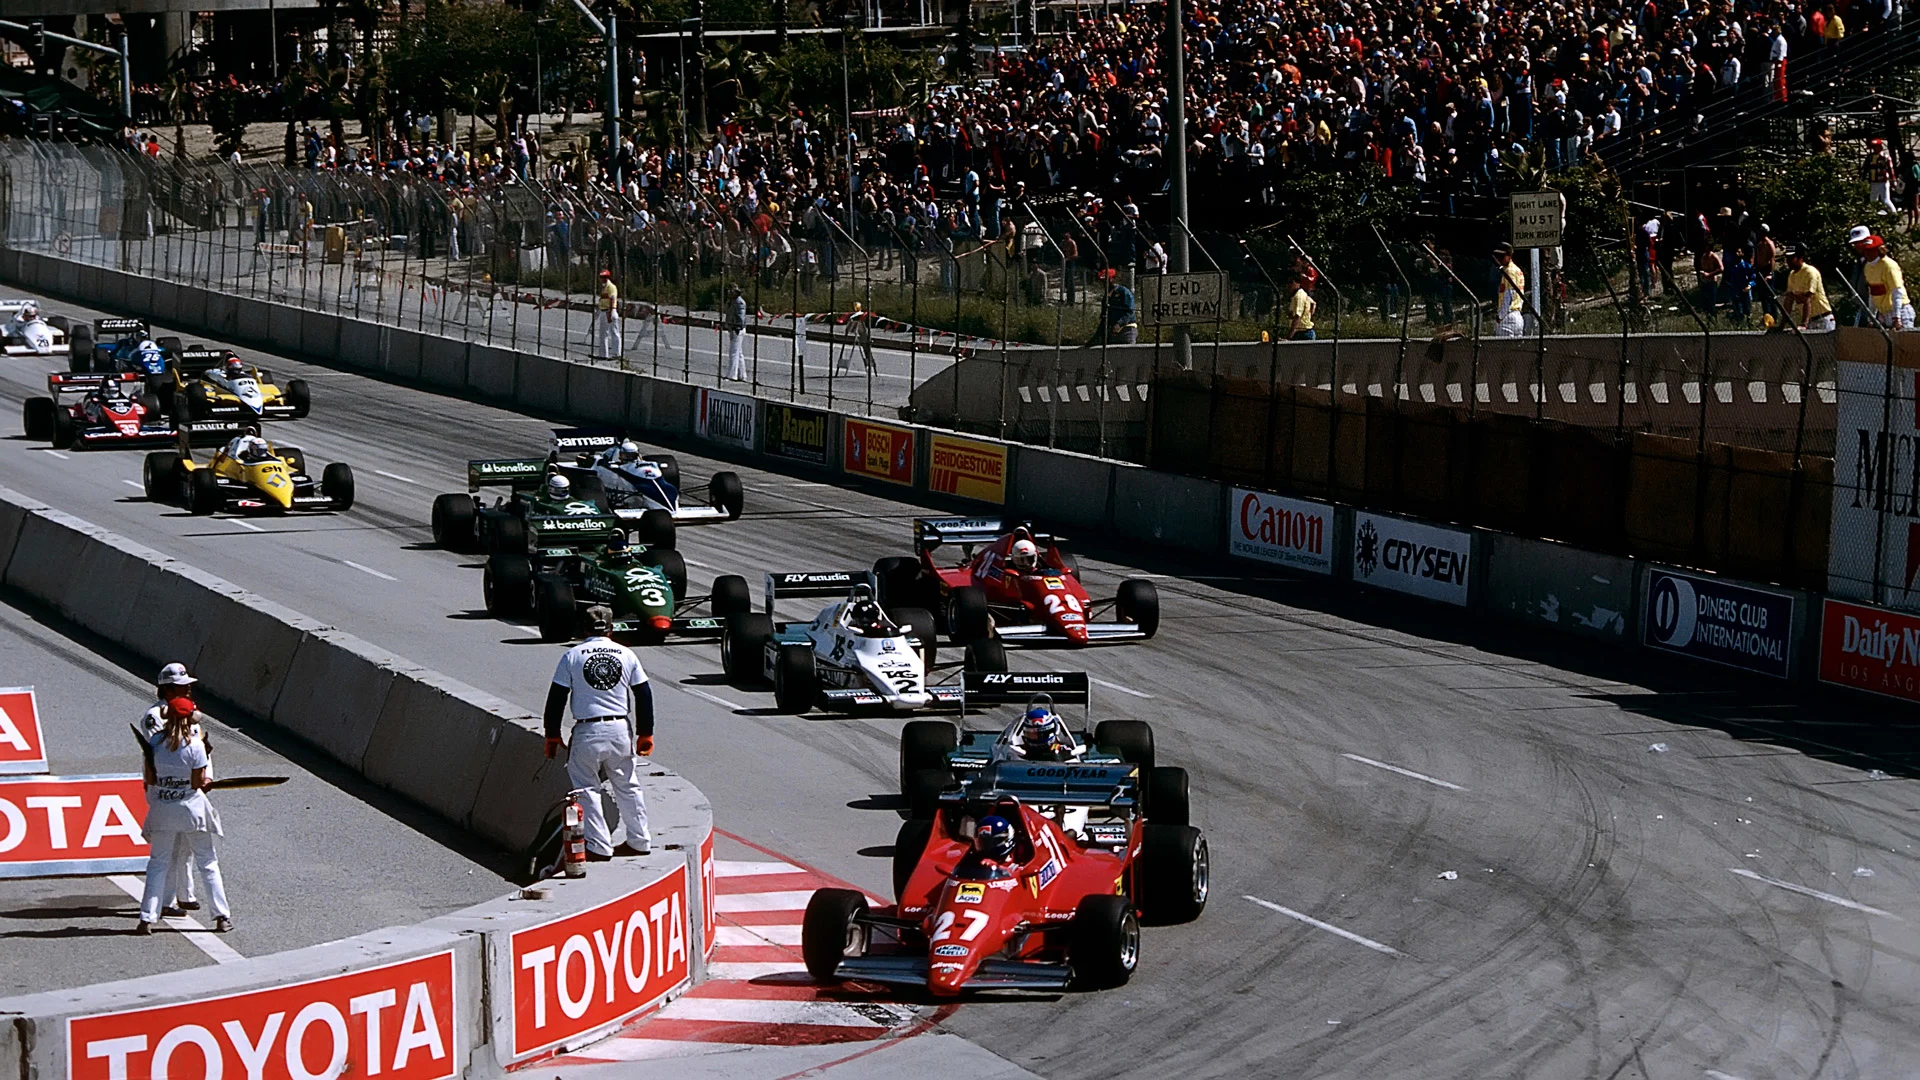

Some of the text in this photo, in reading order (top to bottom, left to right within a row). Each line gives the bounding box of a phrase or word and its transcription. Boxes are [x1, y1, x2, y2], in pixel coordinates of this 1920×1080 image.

[1513, 200, 1558, 209] RIGHT LANE
[1520, 214, 1554, 225] MUST
[1514, 230, 1558, 240] TURN RIGHT
[1170, 282, 1200, 296] END
[226, 422, 238, 430] elf
[709, 398, 752, 442] MICHELOB
[868, 432, 890, 454] BOSCH
[934, 451, 1002, 477] BRIDGESTONE
[1241, 493, 1322, 554] Canon
[1382, 538, 1467, 586] CRYSEN
[784, 572, 850, 582] FLY saudia
[641, 588, 666, 606] 3
[1699, 594, 1768, 630] DINERS CLUB
[1697, 622, 1783, 662] INTERNATIONAL
[1842, 615, 1920, 668] Daily N
[894, 680, 920, 694] 2
[984, 674, 1064, 684] FLY saudia
[1840, 662, 1920, 694] LOS ANG
[931, 909, 990, 942] 27
[519, 891, 687, 1029] TOYOTA
[86, 981, 446, 1080] TOYOTA
